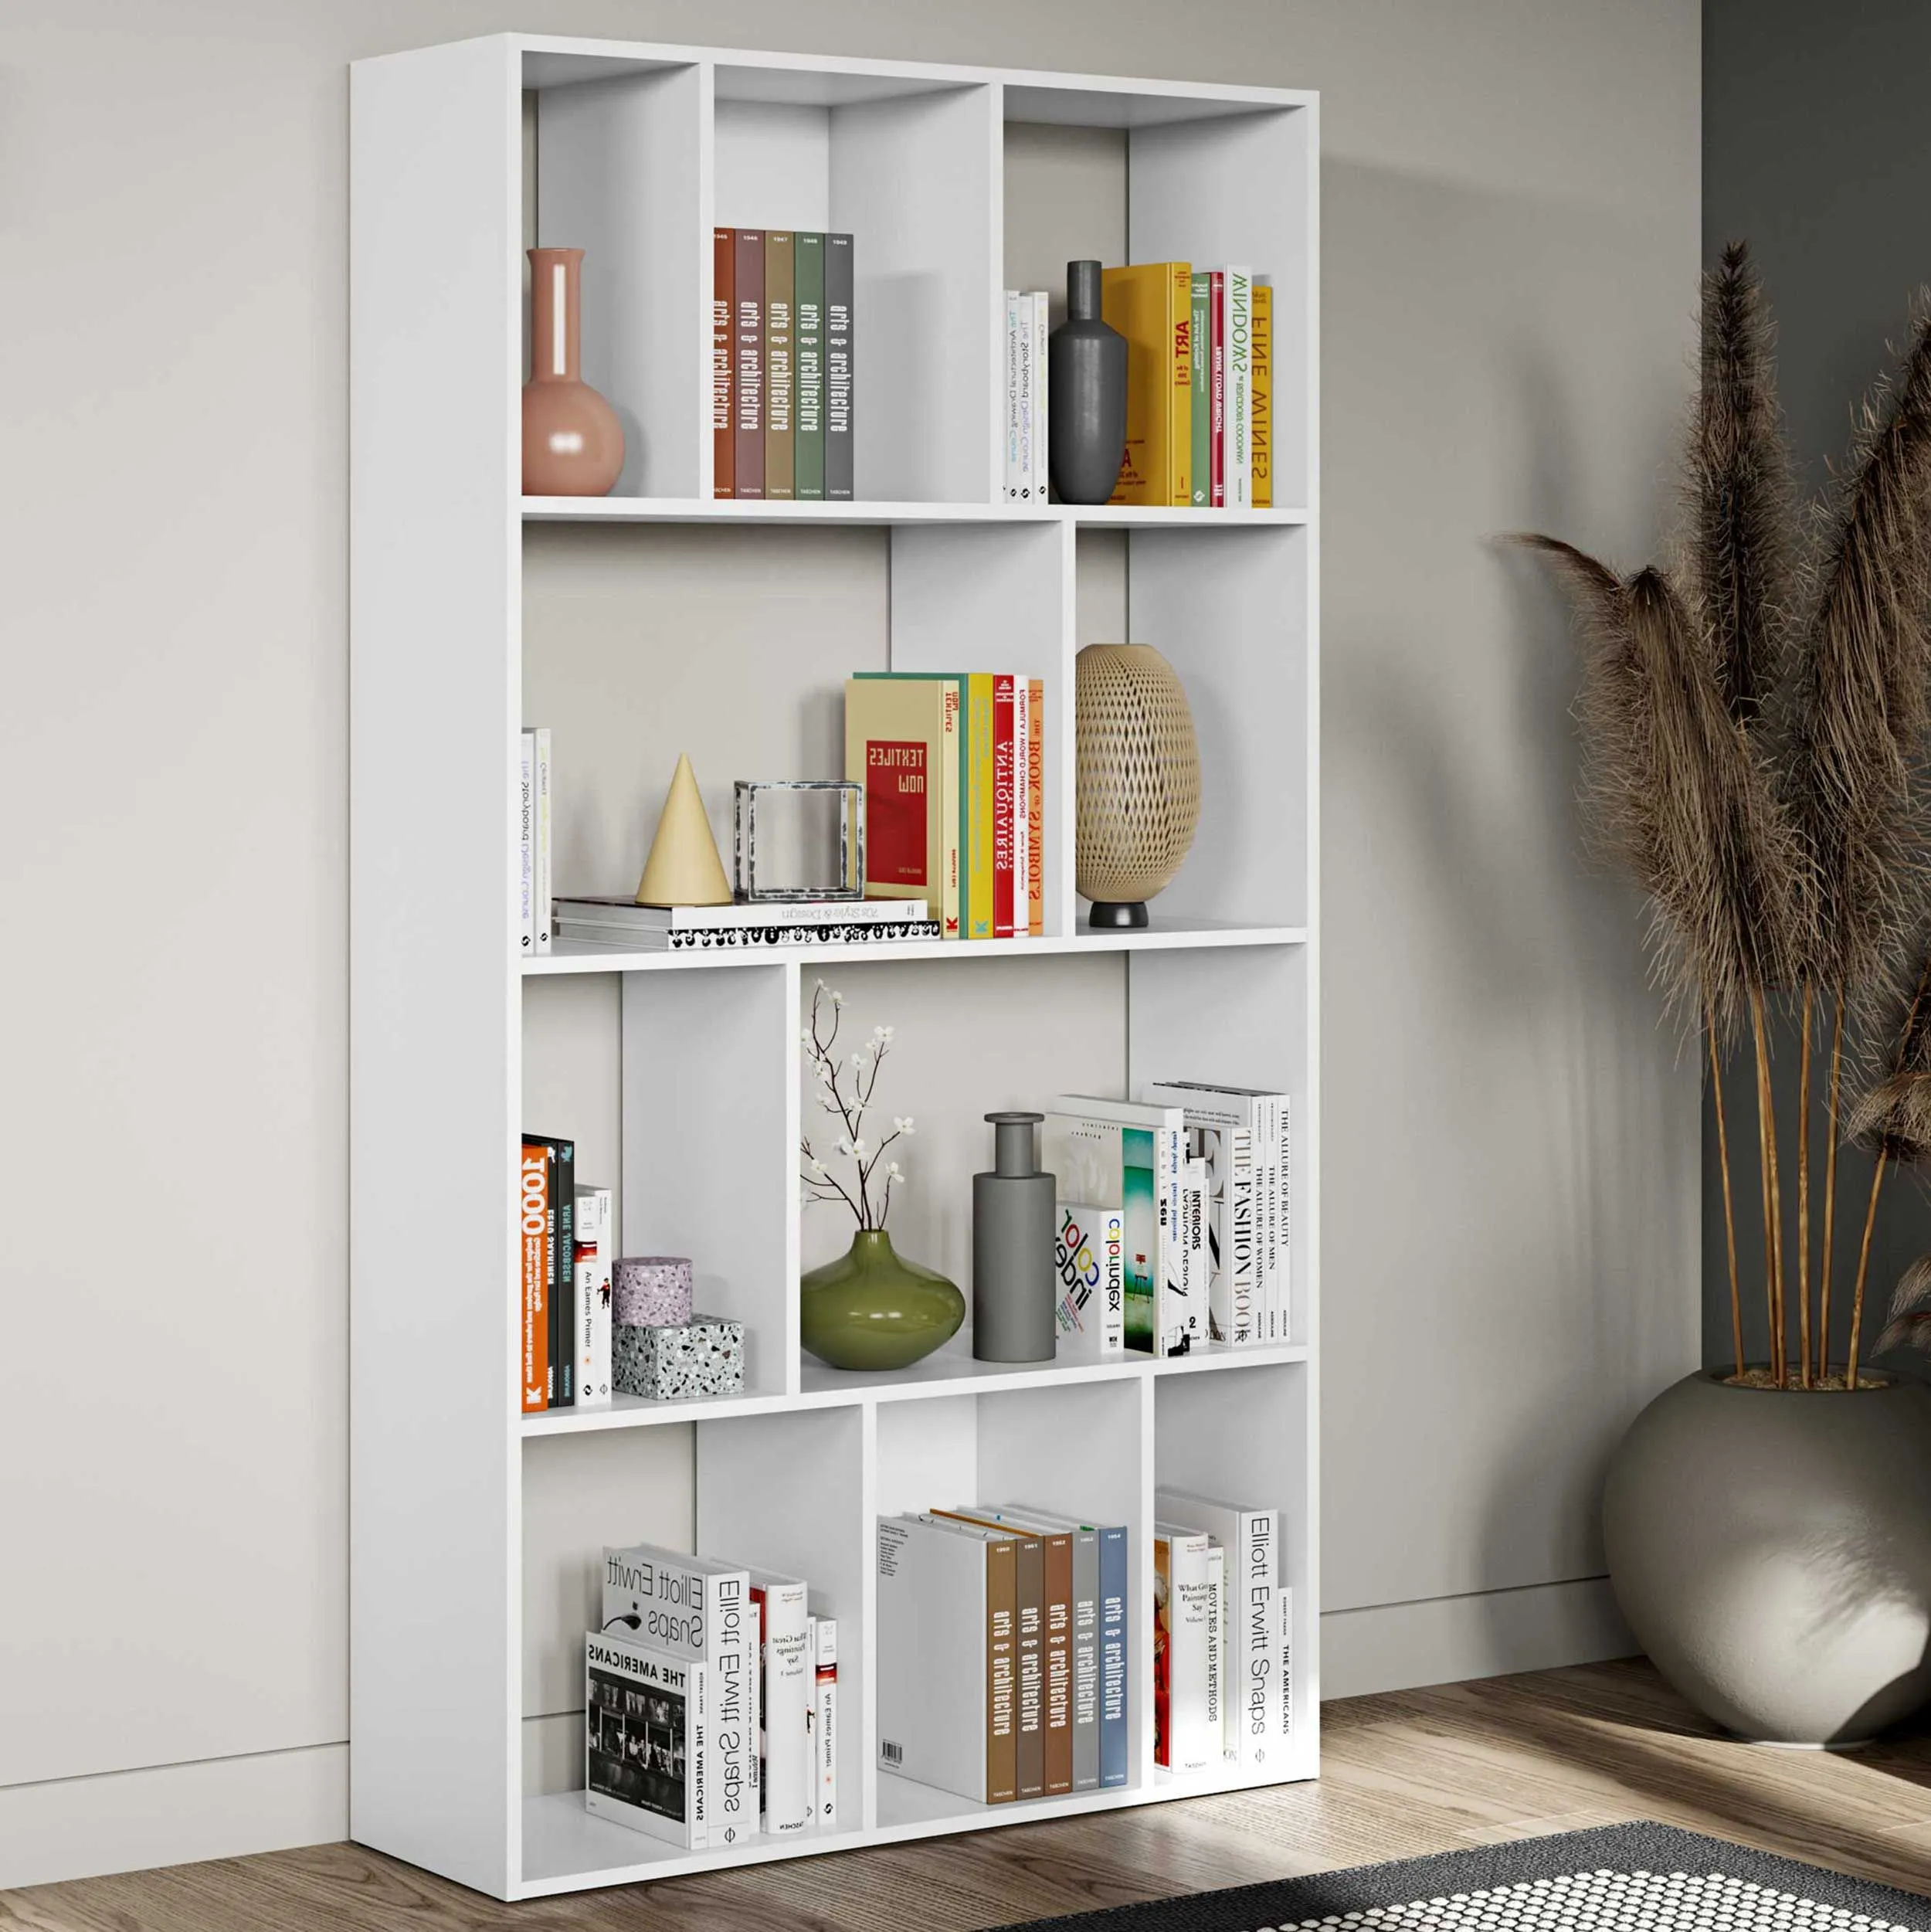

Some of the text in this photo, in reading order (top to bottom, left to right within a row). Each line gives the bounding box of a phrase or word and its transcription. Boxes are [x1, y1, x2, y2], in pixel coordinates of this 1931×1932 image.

[741, 302, 762, 430] arts & architecture
[771, 303, 792, 430] arts & architecture
[800, 304, 822, 431] arts & architecture
[830, 306, 850, 331] arts
[830, 353, 851, 432] architecture
[1235, 1130, 1252, 1177] THE
[1281, 1109, 1289, 1246] THE ALLURE OF BEAUTY
[1193, 1190, 1201, 1250] INTERIORS
[1235, 1181, 1252, 1275] FASHION
[1256, 1232, 1264, 1246] OF
[1268, 1231, 1275, 1244] OF
[585, 1272, 593, 1347] An Eames Primer
[1189, 1316, 1196, 1329] 2
[993, 1611, 1014, 1735] arts & architecture
[1022, 1608, 1042, 1732] arts & architecture
[1050, 1604, 1070, 1727] arts & architecture
[1077, 1601, 1098, 1723] arts & architecture
[1105, 1597, 1125, 1720] arts & architecture
[1208, 1584, 1217, 1722] MOVIES AND METHODS
[1247, 1517, 1270, 1735] Elliott Erwitt Snaps
